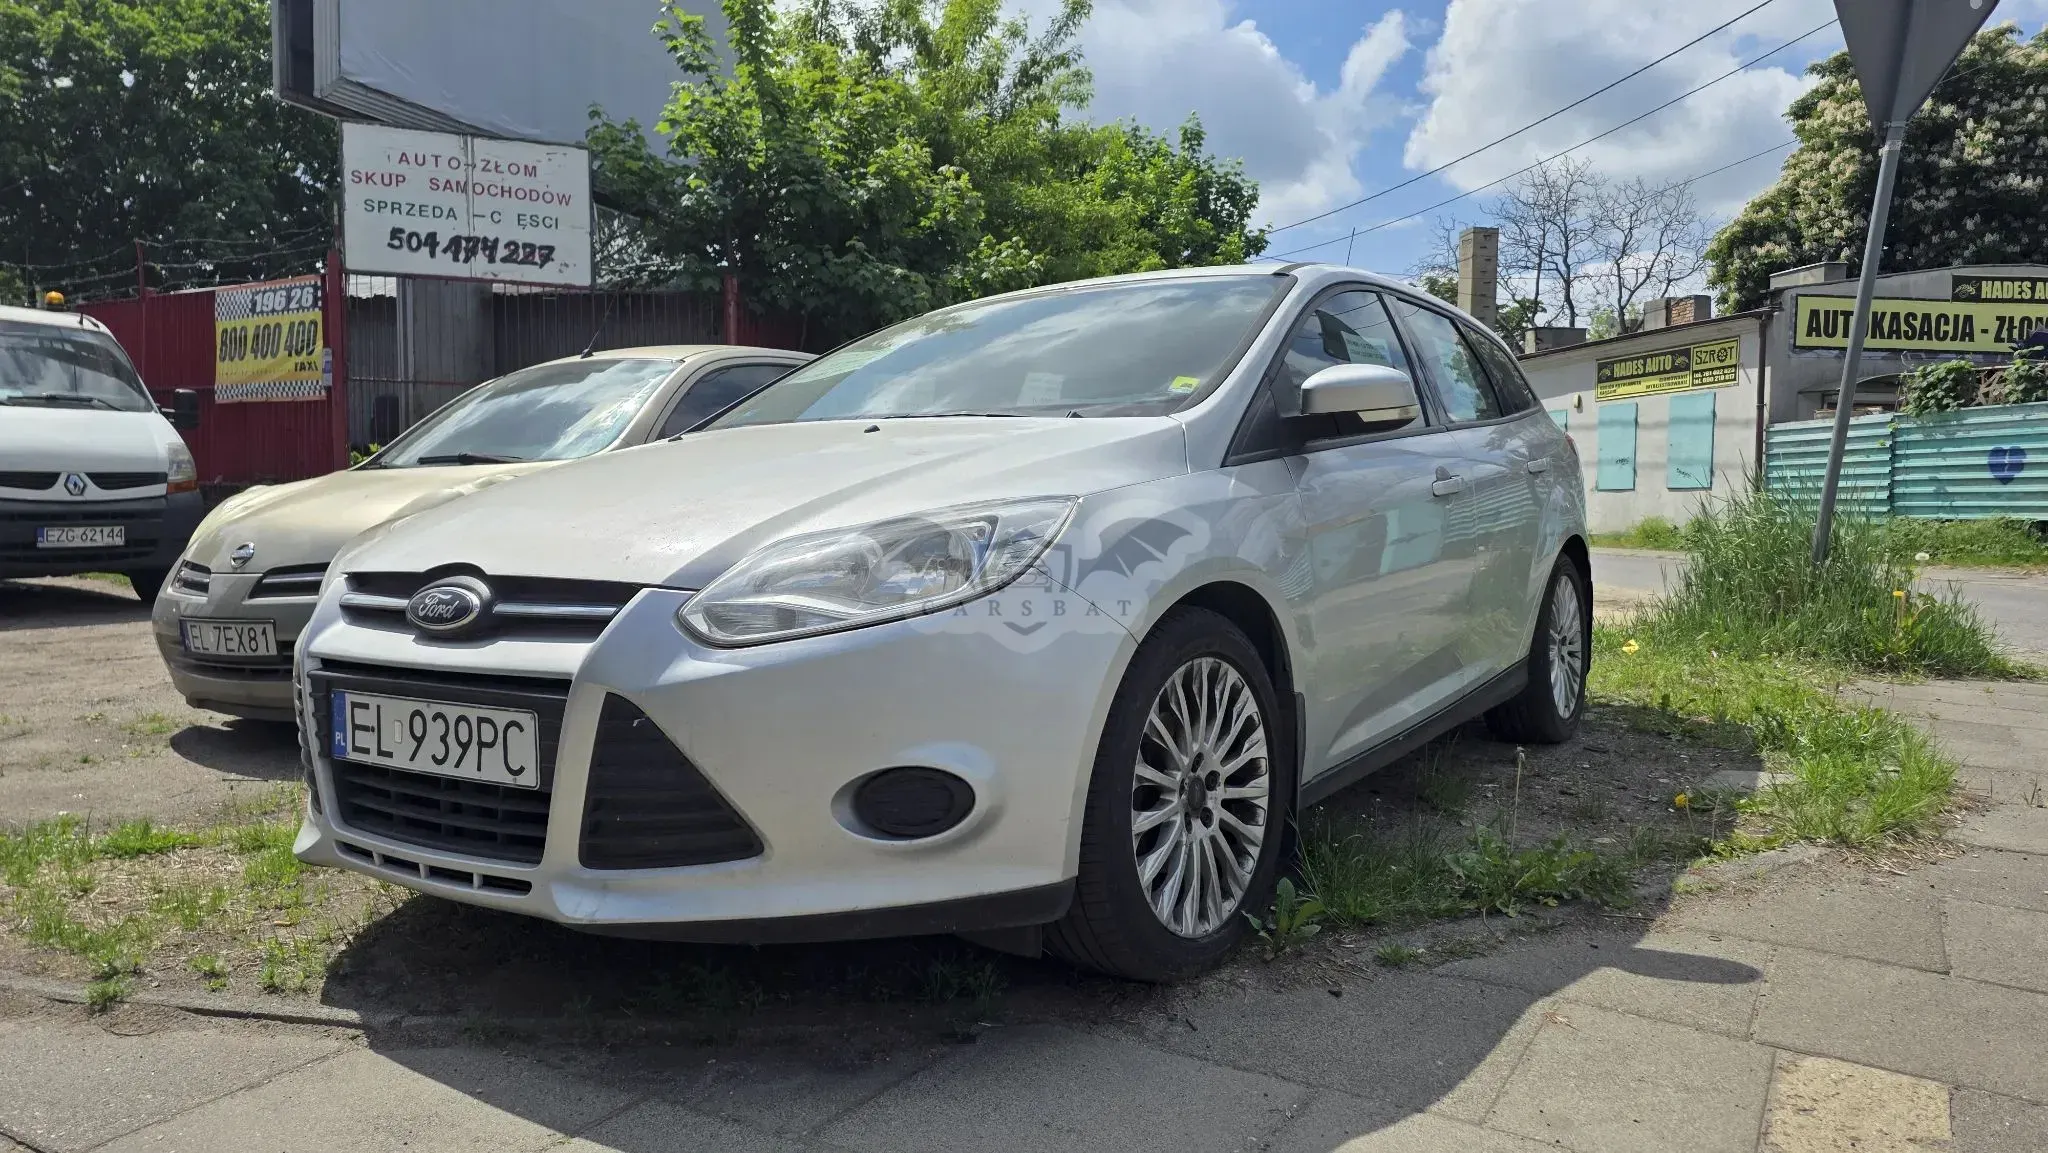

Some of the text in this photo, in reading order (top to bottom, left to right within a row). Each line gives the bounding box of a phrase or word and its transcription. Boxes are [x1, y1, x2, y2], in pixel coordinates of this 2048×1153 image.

[350, 170, 572, 207] SKUP SAMOCHODÓW
[254, 286, 314, 313] 196 26
[1981, 280, 2048, 300] HADES A
[1805, 308, 1975, 343] AUTKASACJA
[219, 319, 318, 363] 800 400 400
[1613, 354, 1673, 378] HADES AUTO
[45, 528, 76, 543] EZG
[80, 527, 123, 543] 62144
[418, 592, 460, 619] Ford
[189, 624, 271, 653] EL 7EX81
[334, 700, 526, 777] PL EL 939PC
